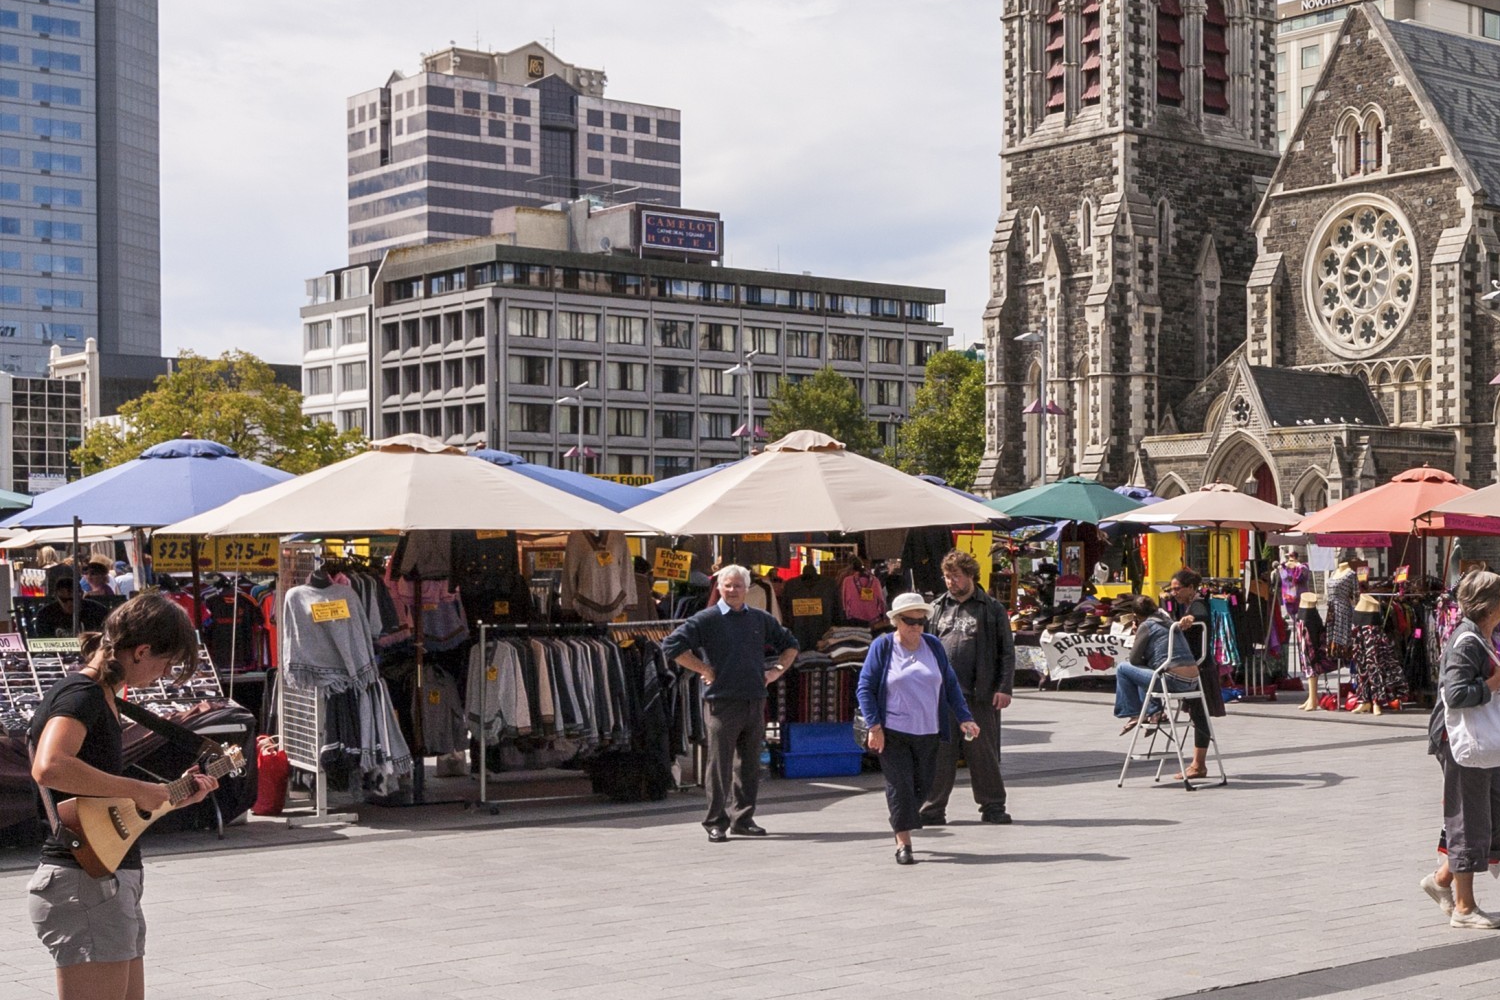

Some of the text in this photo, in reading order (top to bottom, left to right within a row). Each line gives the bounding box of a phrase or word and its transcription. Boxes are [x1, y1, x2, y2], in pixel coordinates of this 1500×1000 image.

[647, 216, 714, 233] CAMELOT
[656, 228, 684, 236] CATHEDRAL
[647, 234, 714, 249] HOTEL
[620, 476, 652, 486] FOOD
[660, 550, 688, 562] Eftpos
[662, 559, 684, 570] Here
[1075, 645, 1119, 657] HATS
